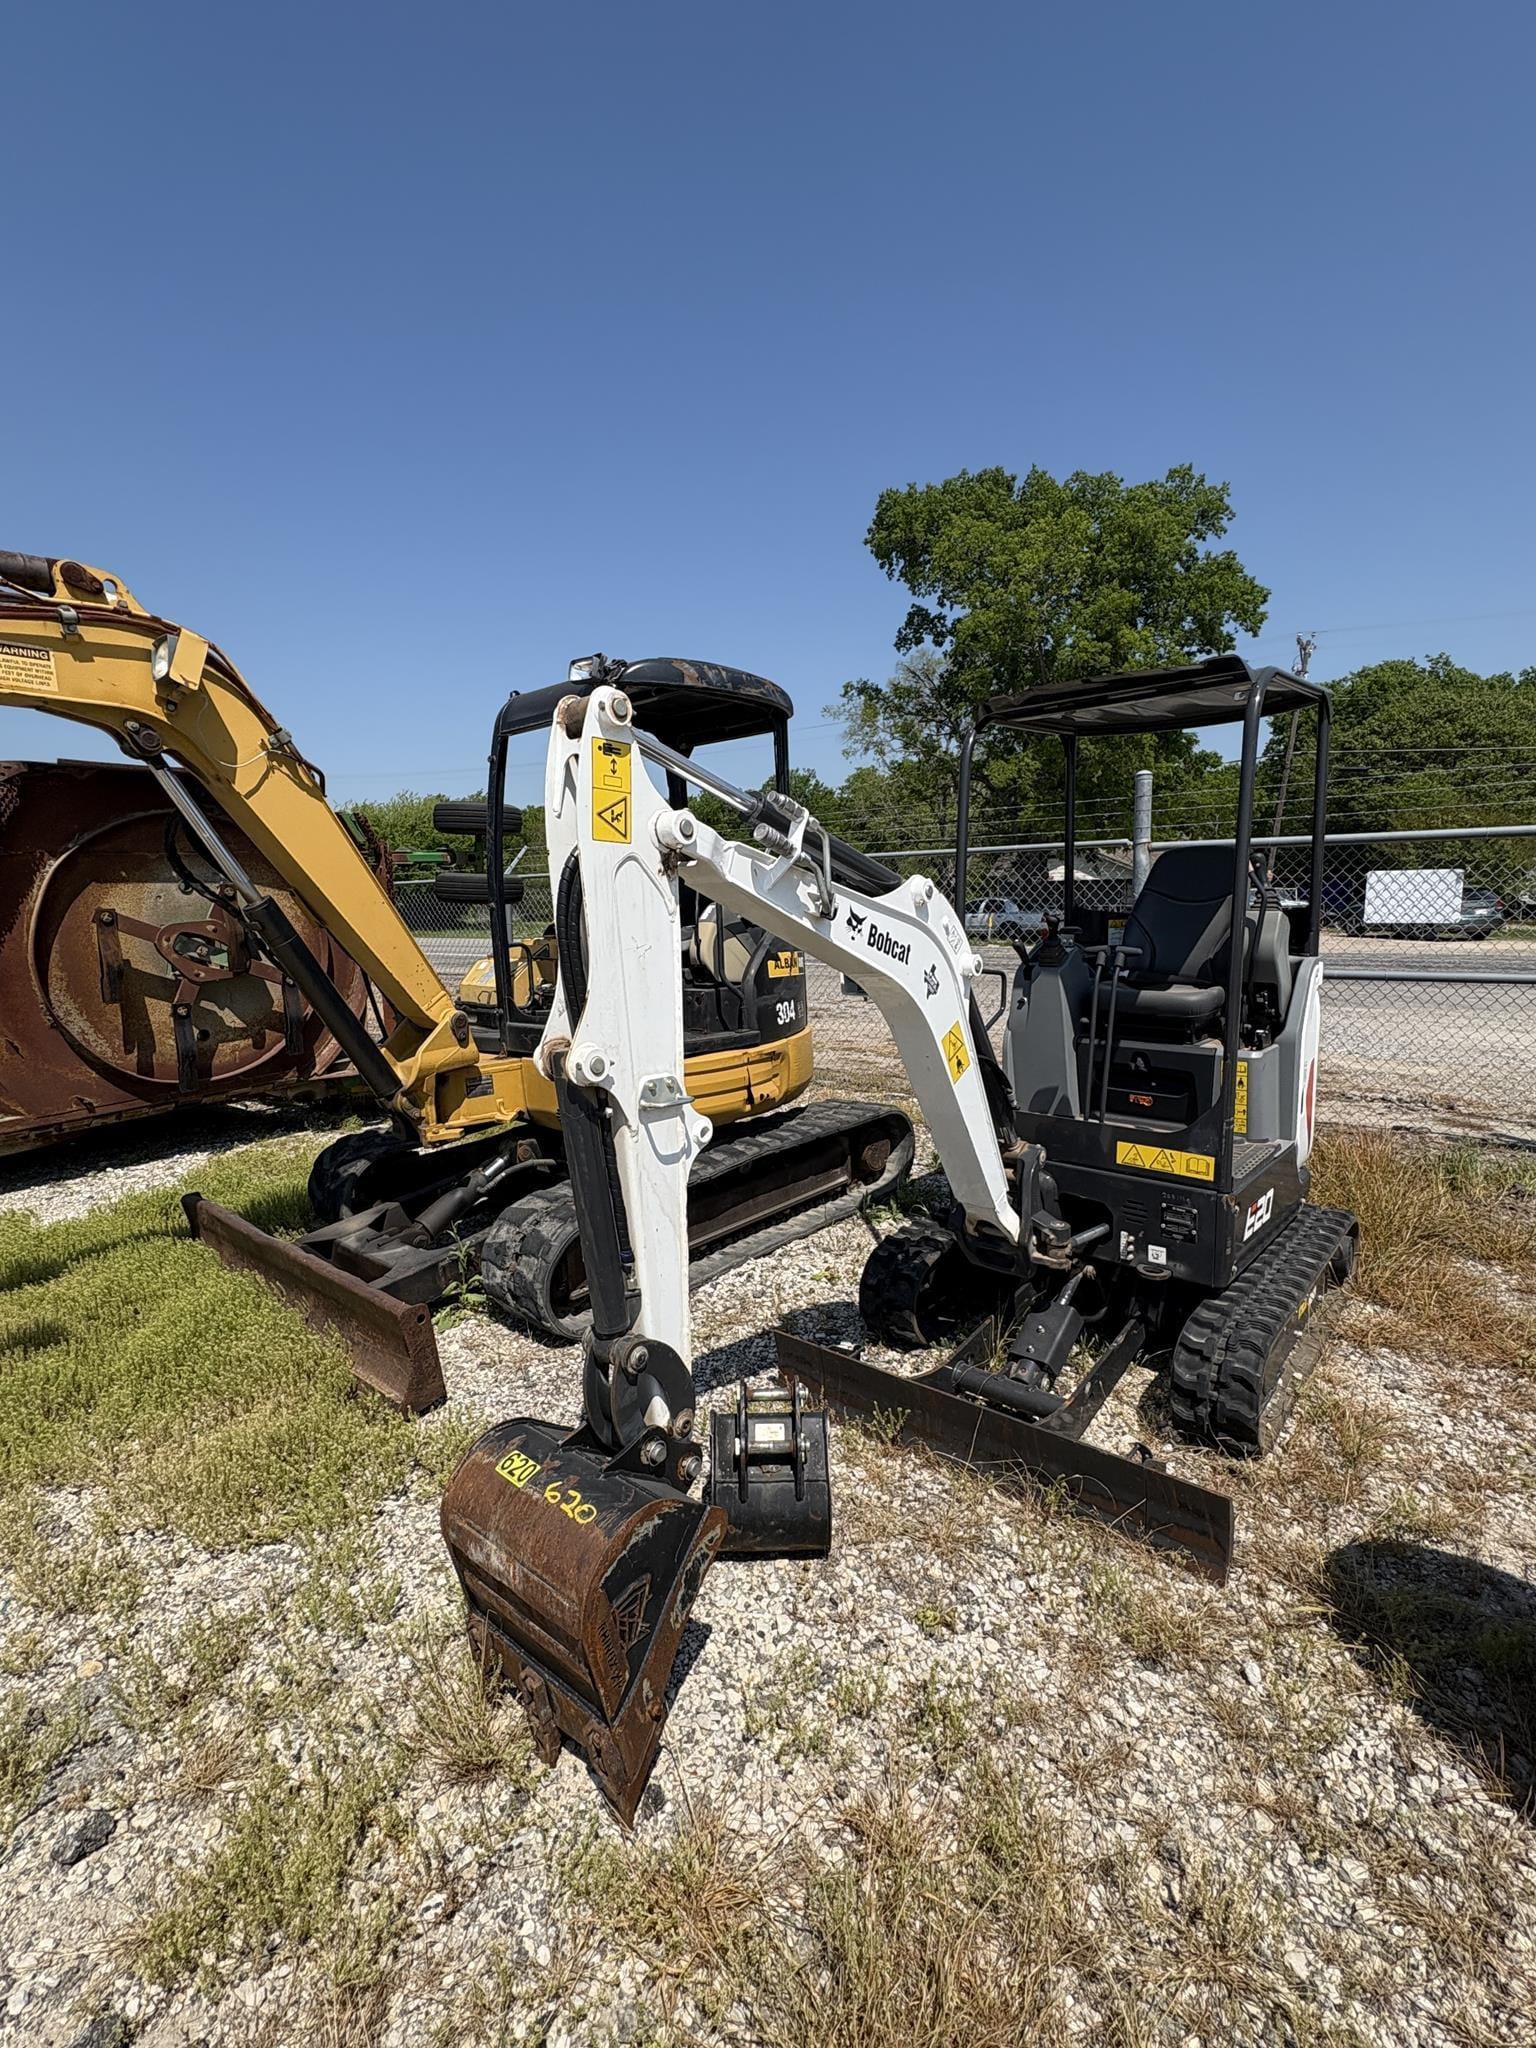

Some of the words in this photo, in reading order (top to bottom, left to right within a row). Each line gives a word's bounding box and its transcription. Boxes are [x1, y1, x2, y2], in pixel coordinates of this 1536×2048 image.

[867, 923, 911, 965] Bobcat
[775, 999, 796, 1025] 304
[1243, 1187, 1275, 1242] E20
[500, 1453, 538, 1482] 620
[544, 1481, 597, 1524] 620
